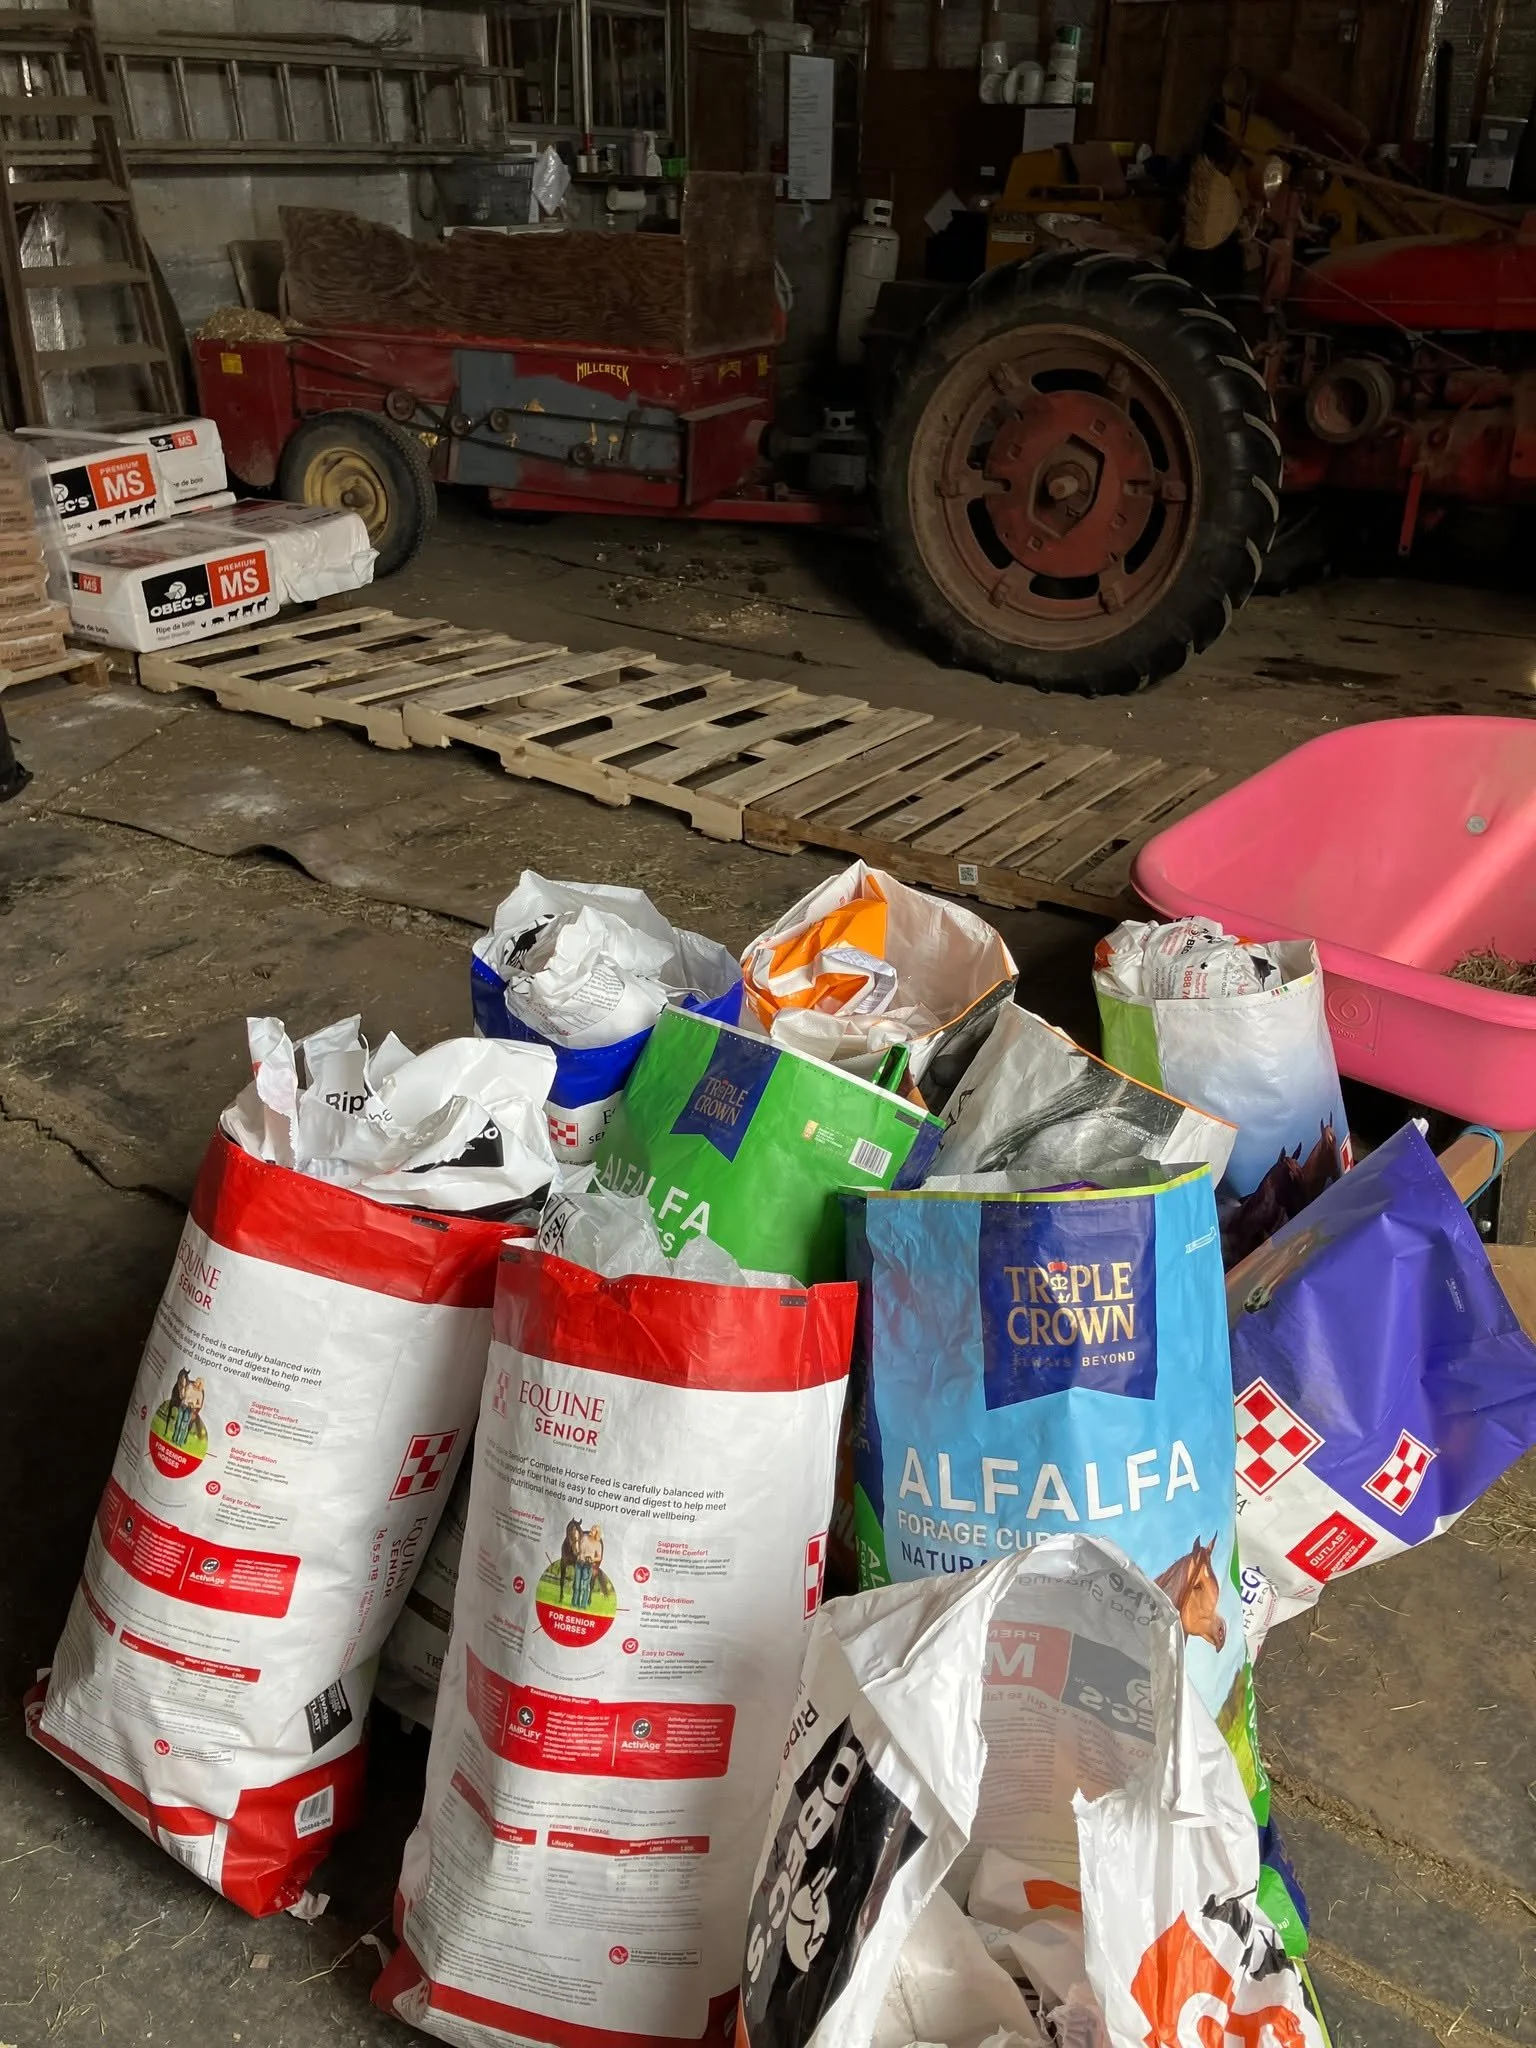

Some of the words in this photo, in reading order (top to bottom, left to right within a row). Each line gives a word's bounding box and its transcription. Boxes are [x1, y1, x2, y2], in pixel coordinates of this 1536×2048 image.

[576, 361, 630, 387] MILLCREEK
[178, 435, 193, 447] MS
[100, 461, 140, 476] PREMIUM
[102, 470, 145, 502] MS
[56, 495, 91, 513] EC'S
[218, 559, 256, 573] PREMIUM
[83, 579, 98, 592] MS
[219, 567, 260, 600] MS
[150, 593, 207, 617] OBEC'S
[694, 1094, 741, 1126] CROWN
[178, 1239, 222, 1290] EQUINE
[179, 1273, 213, 1310] SENIOR
[1007, 1303, 1136, 1346] CROWN
[201, 1333, 219, 1347] Feed
[220, 1341, 227, 1350] is
[228, 1345, 263, 1362] carefully
[264, 1355, 302, 1371] balanced
[303, 1366, 321, 1376] with
[206, 1348, 227, 1361] chew
[228, 1355, 243, 1366] and
[244, 1358, 270, 1375] digest
[271, 1367, 280, 1377] to
[281, 1370, 300, 1382] help
[300, 1375, 322, 1386] meet
[1082, 1351, 1136, 1366] BEYOND
[194, 1353, 223, 1370] support
[223, 1365, 251, 1379] overall
[251, 1374, 293, 1392] wellbeing.
[252, 1401, 280, 1413] Supports
[519, 1380, 605, 1423] EQUINE
[534, 1417, 599, 1446] SENIOR
[157, 1452, 180, 1470] HORSES
[164, 1447, 188, 1465] SENIOR
[529, 1458, 564, 1476] Complete
[564, 1468, 589, 1482] Horse
[590, 1474, 612, 1487] Feed
[612, 1478, 620, 1488] is
[622, 1481, 661, 1496] carefully
[663, 1487, 704, 1499] balanced
[706, 1490, 724, 1499] with
[899, 1438, 1201, 1522] ALFALFA
[543, 1475, 558, 1487] that
[559, 1479, 566, 1487] is
[566, 1482, 586, 1495] easy
[587, 1487, 596, 1496] to
[597, 1489, 622, 1501] chew
[623, 1494, 641, 1505] and
[642, 1498, 671, 1511] digest
[673, 1500, 682, 1509] to
[684, 1501, 704, 1512] help
[705, 1503, 727, 1511] meet
[544, 1488, 566, 1501] needs
[567, 1495, 583, 1506] and
[584, 1499, 619, 1514] support
[620, 1505, 651, 1518] overall
[652, 1510, 697, 1523] wellbeing.
[897, 1509, 987, 1548] FORAGE
[657, 1540, 689, 1549] Supports
[1309, 1528, 1348, 1567] OUTLAST
[189, 1571, 227, 1585] ActivAge
[384, 1539, 402, 1600] SENIOR
[643, 1595, 660, 1604] Body
[662, 1597, 694, 1605] Condition
[549, 1611, 564, 1621] FOR
[565, 1615, 595, 1628] SENIOR
[554, 1621, 587, 1635] HORSES
[508, 1723, 541, 1740] AMPLIFY
[783, 1700, 820, 1761] Ripe
[621, 1740, 661, 1750] ActivAge
[551, 1840, 574, 1848] Lifestyle
